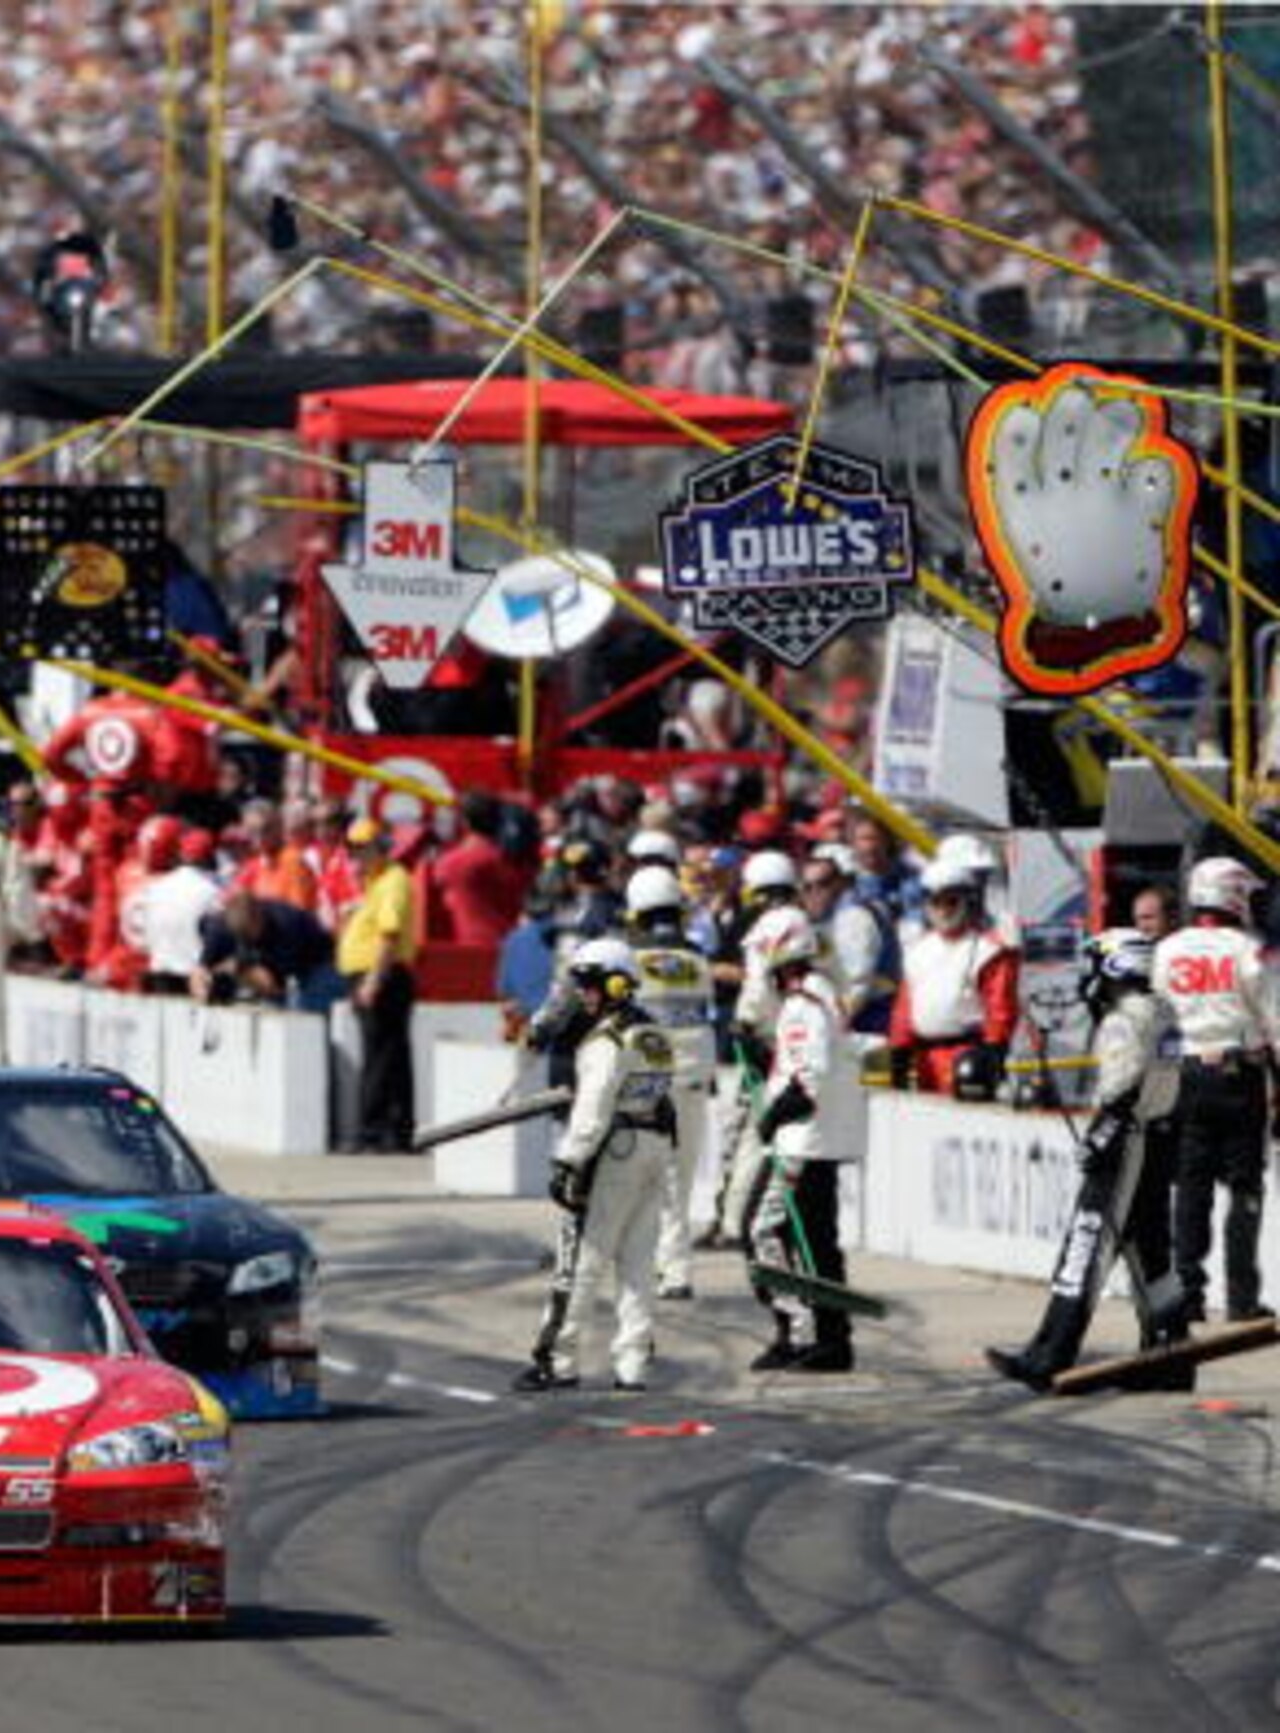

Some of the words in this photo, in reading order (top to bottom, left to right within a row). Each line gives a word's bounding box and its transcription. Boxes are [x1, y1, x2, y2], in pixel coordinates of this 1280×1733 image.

[373, 519, 442, 561] 3M
[698, 512, 880, 572] LOWE'S
[706, 587, 875, 617] RACING
[368, 623, 437, 662] 3M
[1170, 956, 1236, 994] 3M
[1, 1477, 55, 1506] SS
